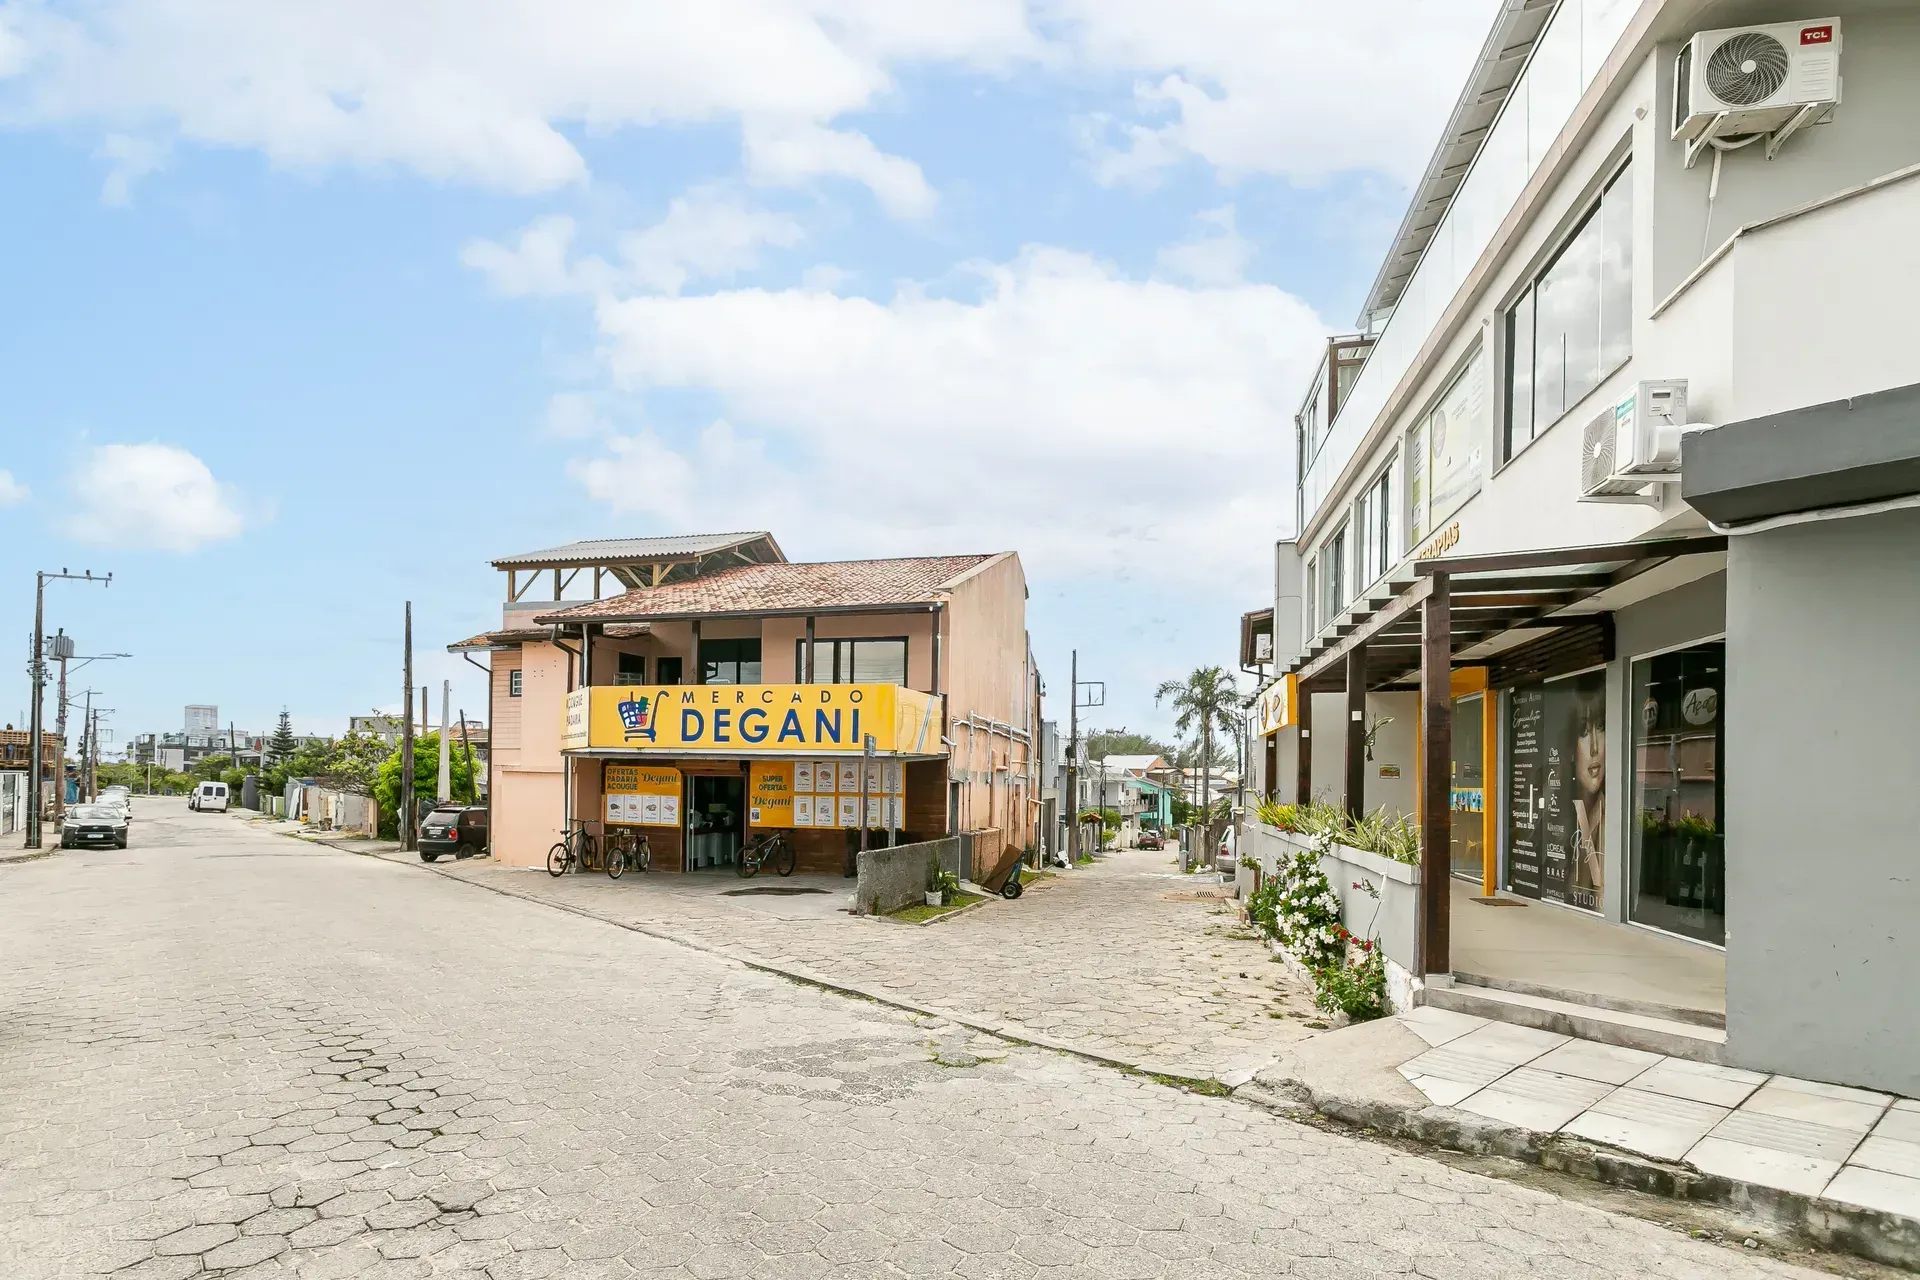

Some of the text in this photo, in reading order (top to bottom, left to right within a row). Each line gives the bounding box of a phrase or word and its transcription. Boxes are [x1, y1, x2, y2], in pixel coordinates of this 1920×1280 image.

[1804, 31, 1828, 40] TCL
[681, 689, 863, 703] MERCADO
[681, 707, 860, 744] DEGANI
[641, 772, 678, 786] Degani
[752, 795, 791, 809] Degani
[1572, 892, 1605, 909] STUDIO
